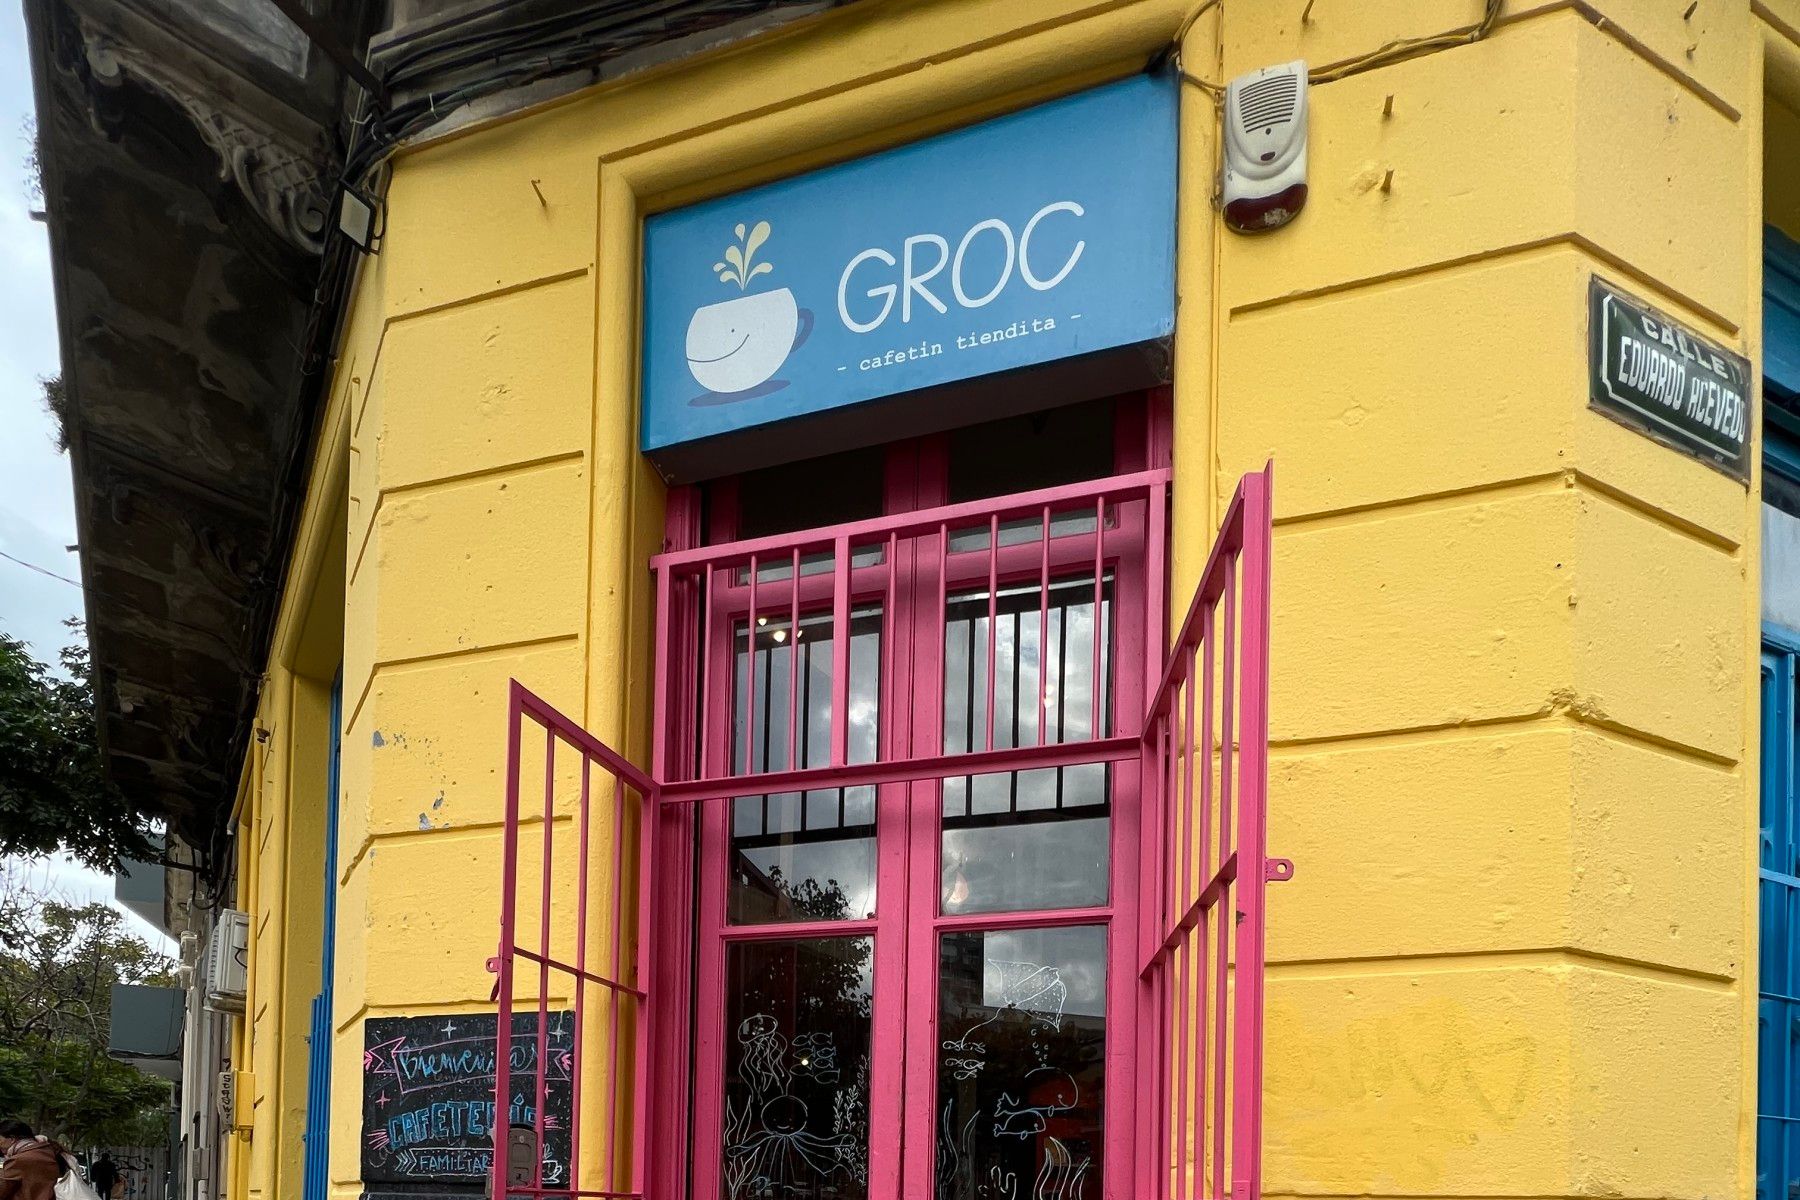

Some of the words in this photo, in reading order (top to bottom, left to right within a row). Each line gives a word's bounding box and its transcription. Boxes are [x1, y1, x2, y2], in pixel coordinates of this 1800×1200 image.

[838, 201, 1085, 333] GROC
[859, 341, 943, 371] cafetin
[956, 315, 1056, 350] tiendita
[1642, 315, 1729, 380] CALLE
[1617, 335, 1686, 411] EDUARDO
[1687, 376, 1746, 444] ACEVEDO
[420, 1154, 488, 1171] FAMILIAR
